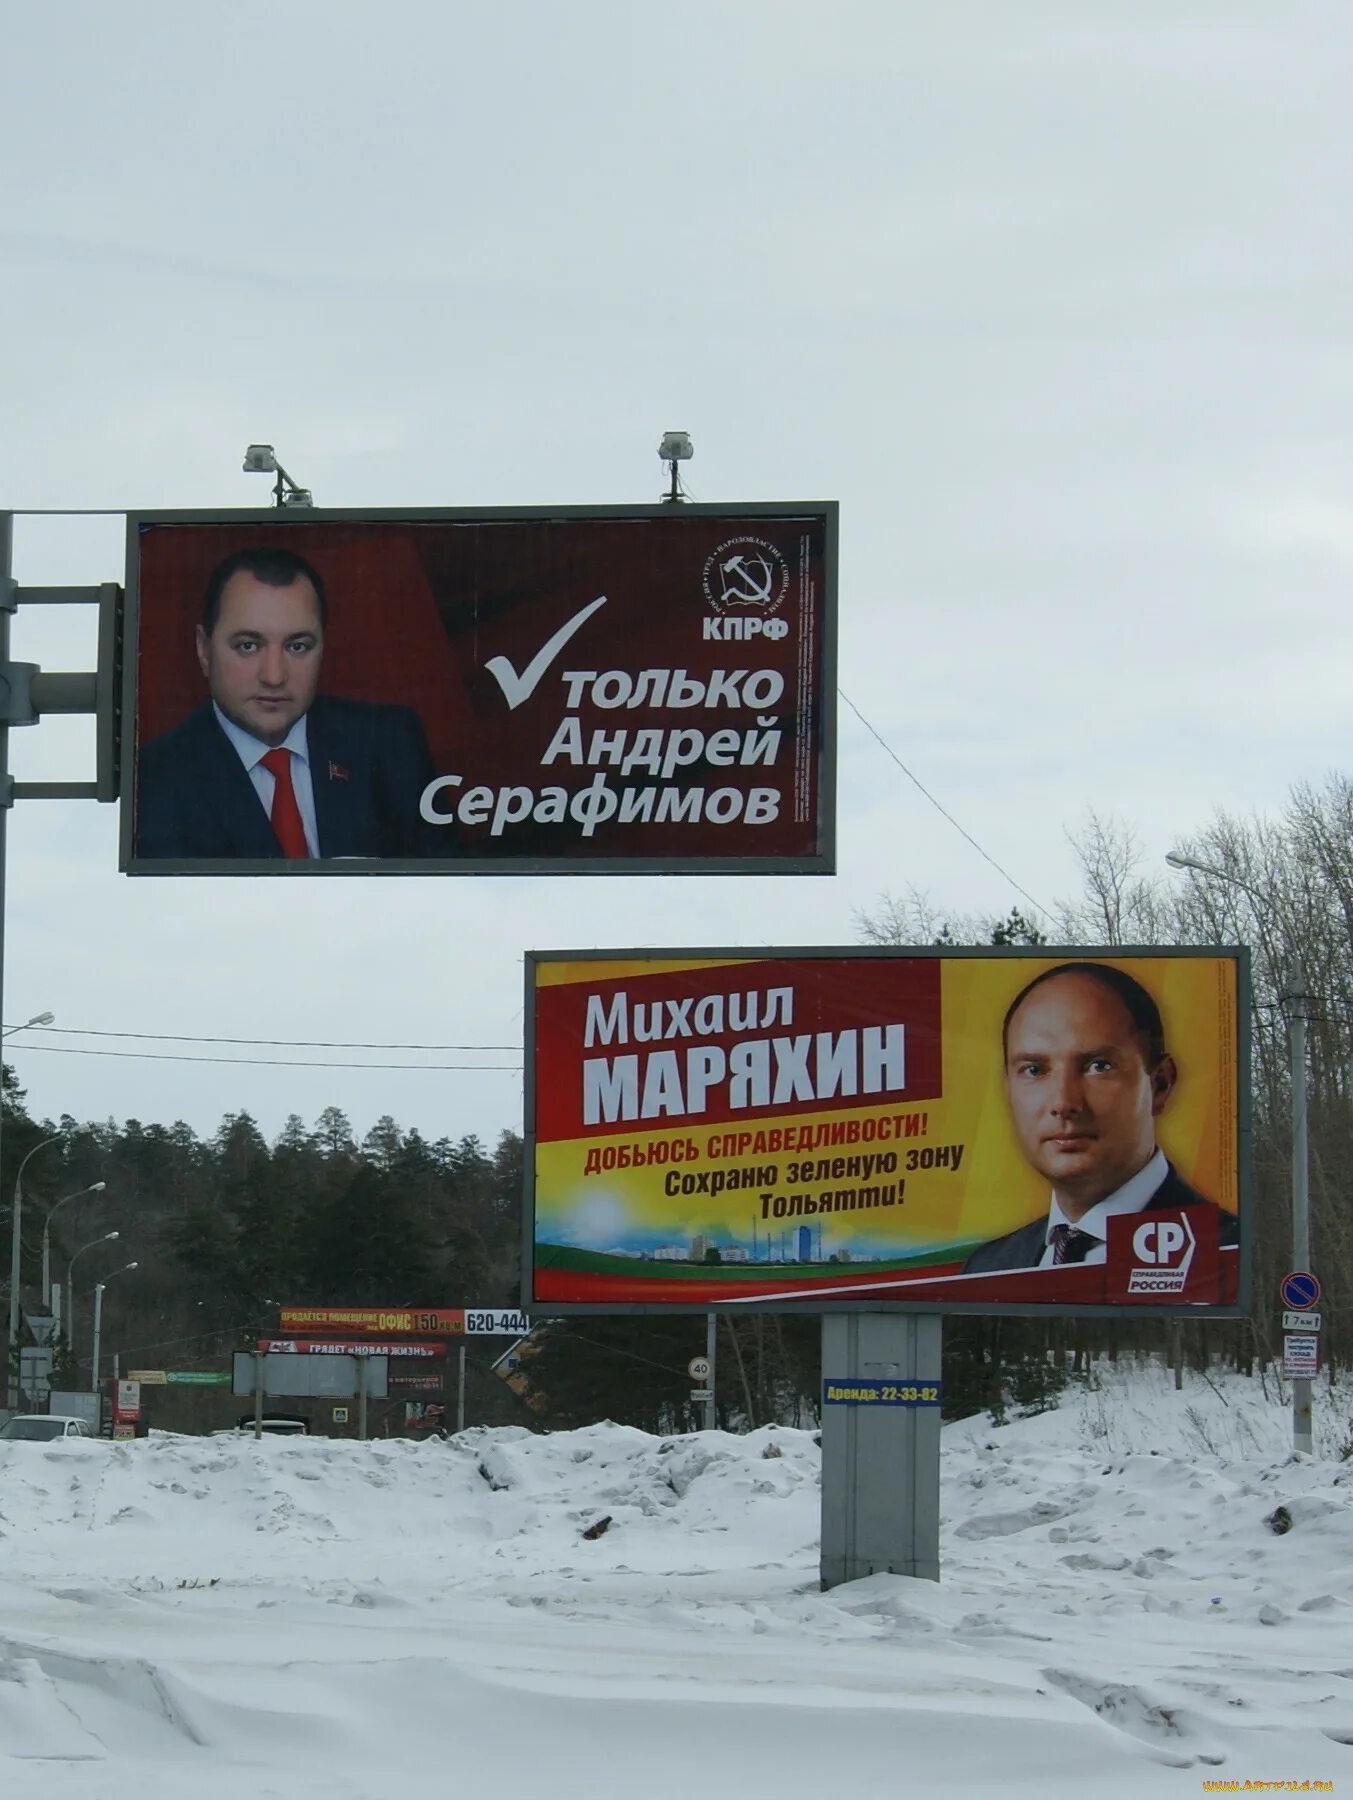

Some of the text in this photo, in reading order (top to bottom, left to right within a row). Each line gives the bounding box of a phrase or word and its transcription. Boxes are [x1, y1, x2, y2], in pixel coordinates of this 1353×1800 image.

[703, 617, 789, 640] КПРФ
[540, 715, 782, 779] Андрей
[419, 772, 782, 837] Серафимов
[584, 986, 795, 1049] Михаил
[583, 1023, 906, 1127] МАРЯХИН
[583, 1112, 928, 1176] ДОБЬЮСЬ СПРАВЕДЛИВОСТИ!
[664, 1143, 965, 1199] Сохраню зеленую зону
[759, 1179, 906, 1220] Тольятти!
[1133, 1222, 1184, 1264] СР
[1130, 1281, 1183, 1290] РОССИЯ
[379, 1313, 411, 1331] ОФИС
[413, 1314, 438, 1331] 150
[467, 1313, 528, 1332] 620-444
[1294, 1316, 1300, 1326] 7
[309, 1344, 345, 1354] ГРЯДЕТ
[694, 1363, 708, 1374] 40
[827, 1386, 937, 1402] Аренда: 22-33-82
